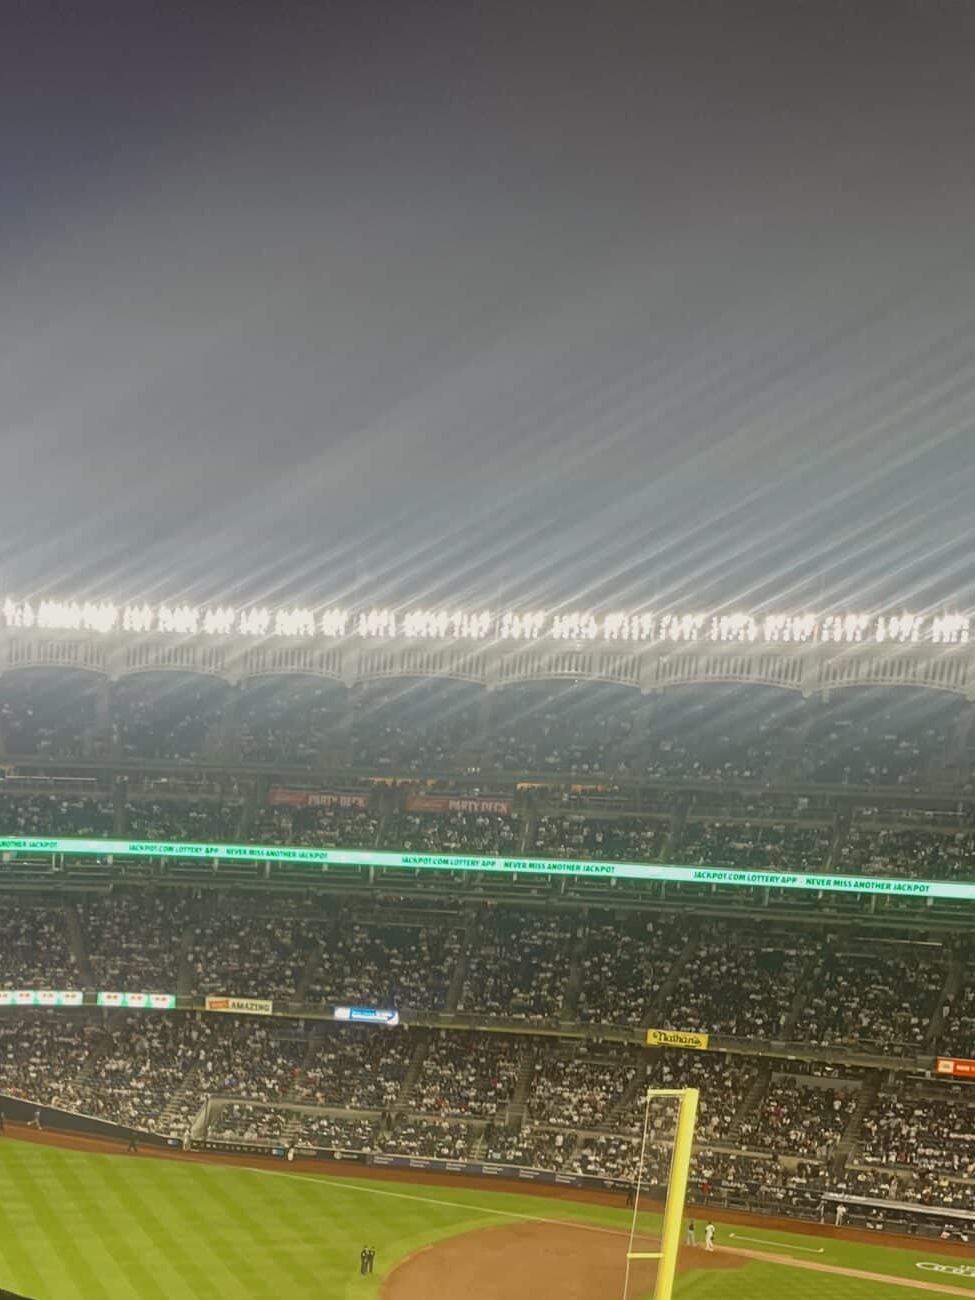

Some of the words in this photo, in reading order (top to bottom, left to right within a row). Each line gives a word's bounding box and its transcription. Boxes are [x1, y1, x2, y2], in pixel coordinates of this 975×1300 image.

[806, 878, 831, 887] NEVER
[833, 879, 852, 888] MISS
[854, 881, 891, 891] ANOTHER
[893, 884, 929, 893] JACKPOT
